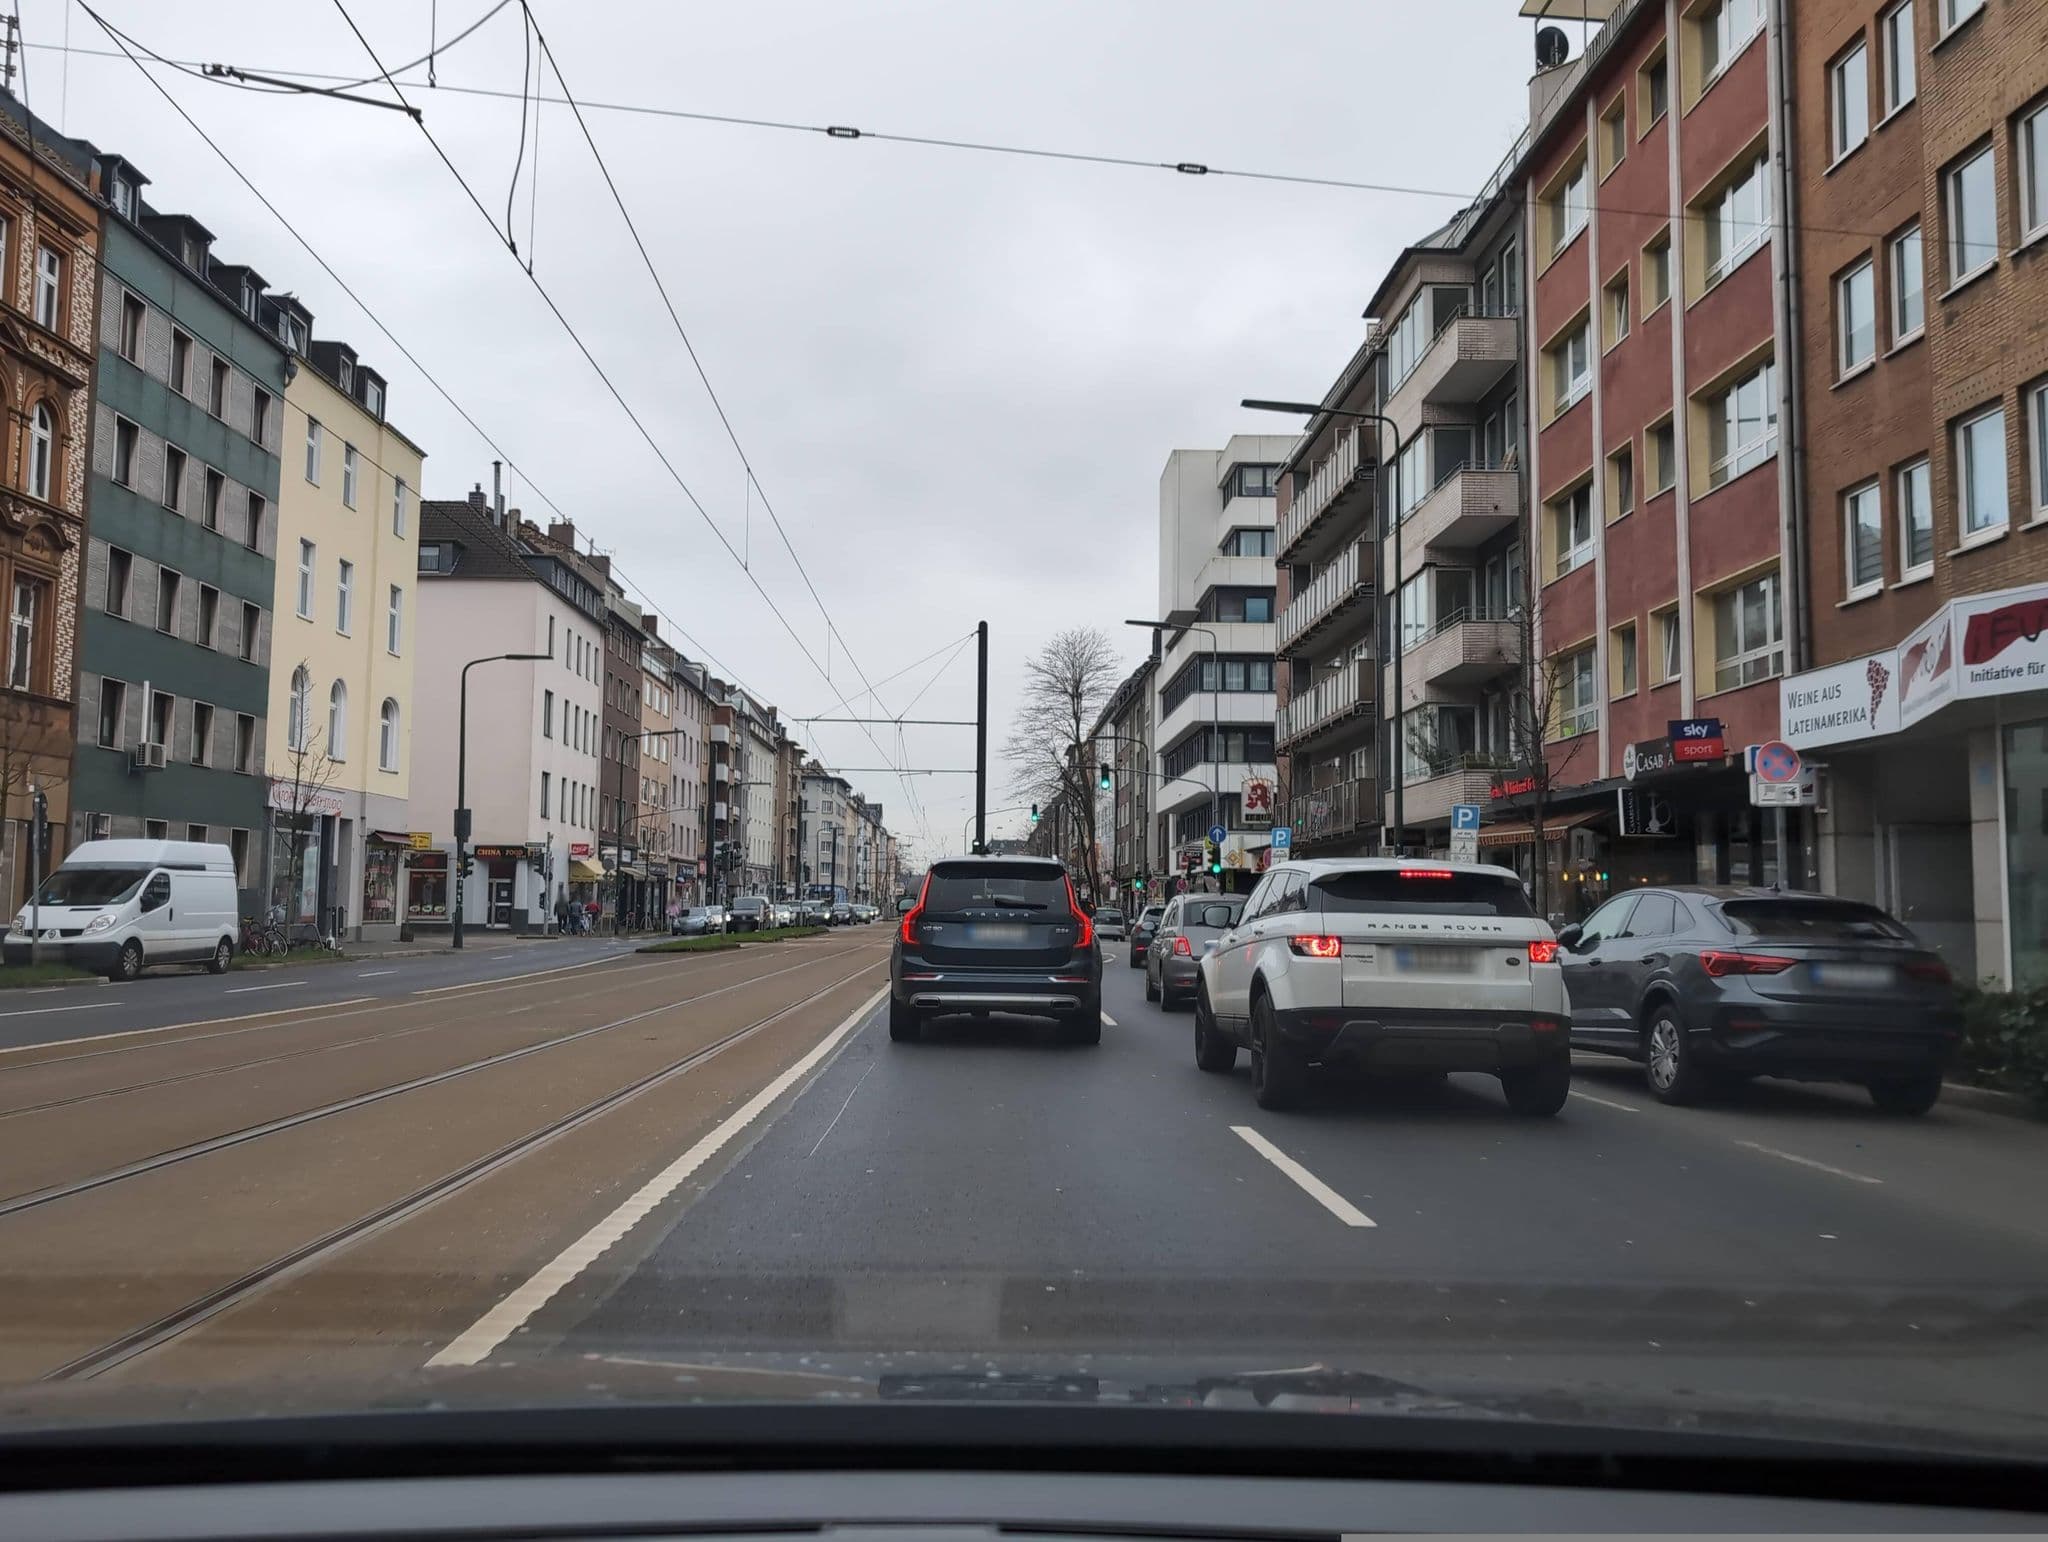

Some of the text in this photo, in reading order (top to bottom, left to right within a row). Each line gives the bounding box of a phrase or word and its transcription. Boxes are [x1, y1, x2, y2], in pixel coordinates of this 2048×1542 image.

[1970, 661, 2046, 683] Initiative für
[1788, 684, 1842, 709] WEINE AUS
[1788, 706, 1867, 736] LATEINAMERIKA
[1683, 723, 1708, 738] sky
[1684, 744, 1713, 756] sport
[1458, 808, 1473, 828] P
[1275, 831, 1286, 846] P
[477, 848, 502, 857] CHINA
[1367, 923, 1503, 932] RANGE ROVER
